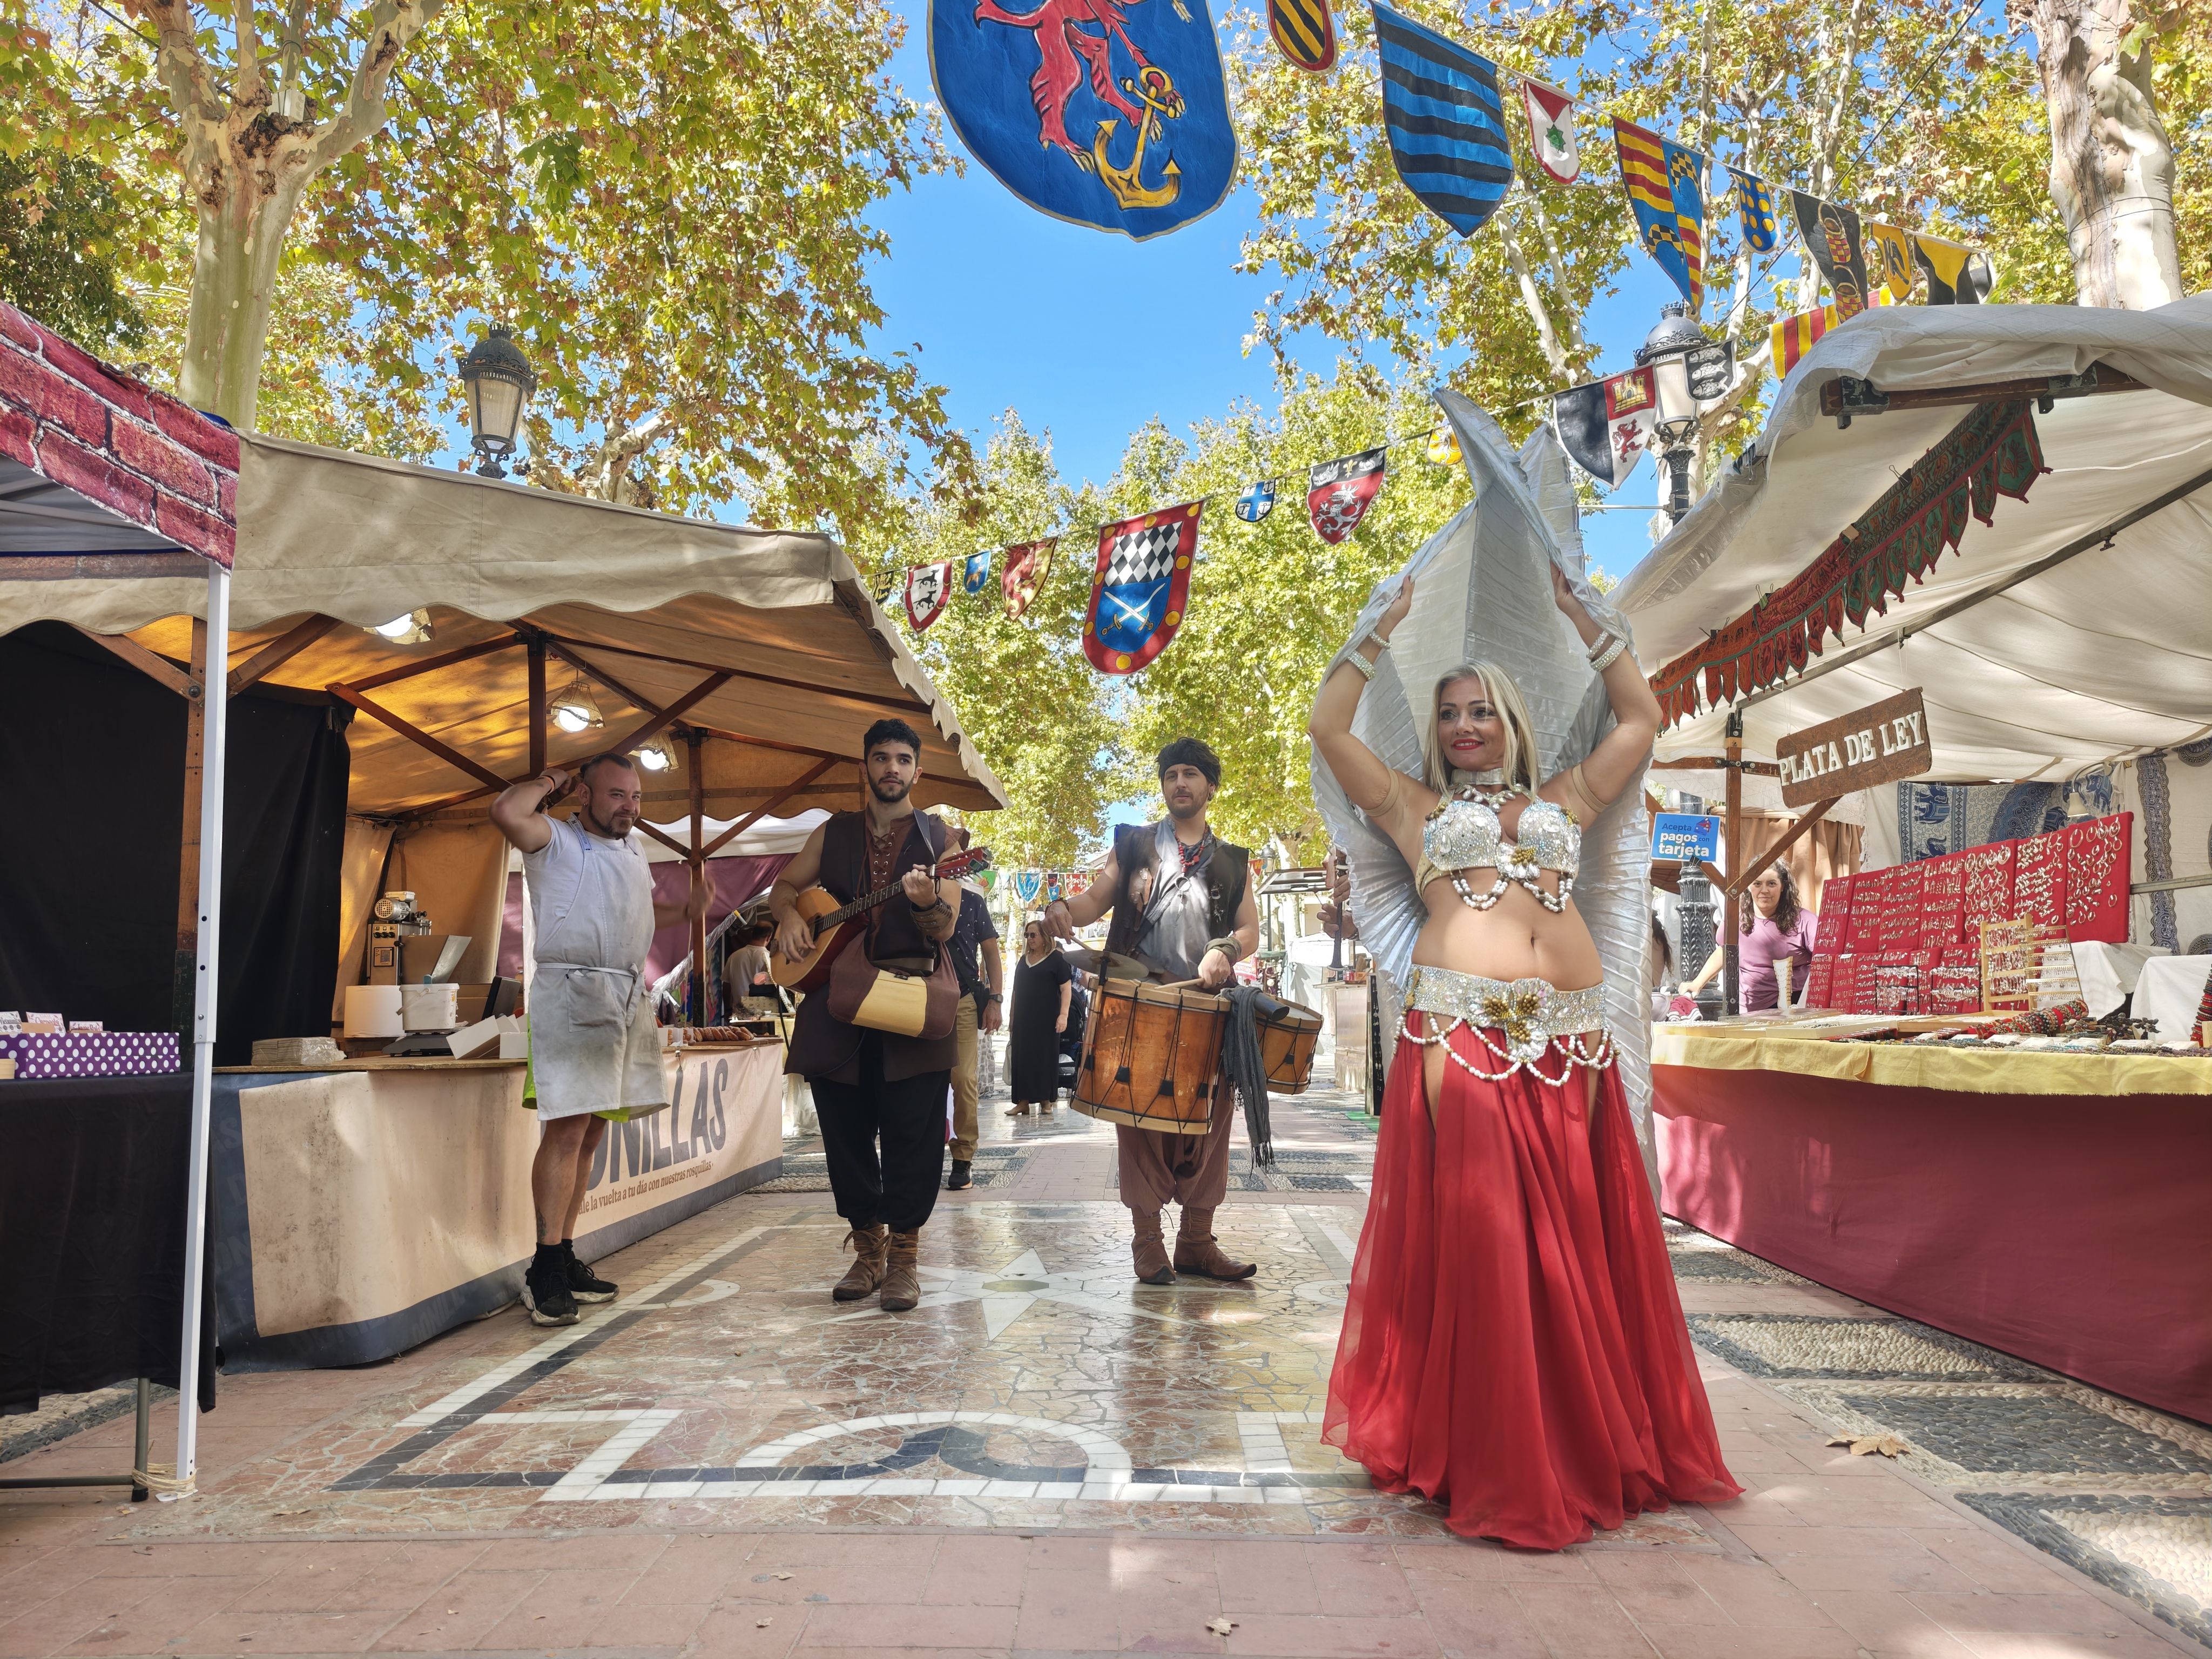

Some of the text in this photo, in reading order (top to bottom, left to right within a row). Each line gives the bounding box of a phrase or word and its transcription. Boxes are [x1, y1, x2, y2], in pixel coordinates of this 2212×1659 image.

[1778, 711, 1925, 786] PLATA DE LEY
[1662, 823, 1692, 832] Acepta
[1660, 833, 1698, 844] pagos
[1658, 842, 1709, 858] tarjeta
[591, 1195, 597, 1211] la
[598, 1189, 622, 1208] vuelta
[623, 1189, 626, 1200] a
[628, 1186, 635, 1198] tu
[637, 1179, 647, 1195] día
[648, 1178, 660, 1191] con
[660, 1171, 686, 1188] nuestras
[686, 1159, 711, 1178] rosquillas
